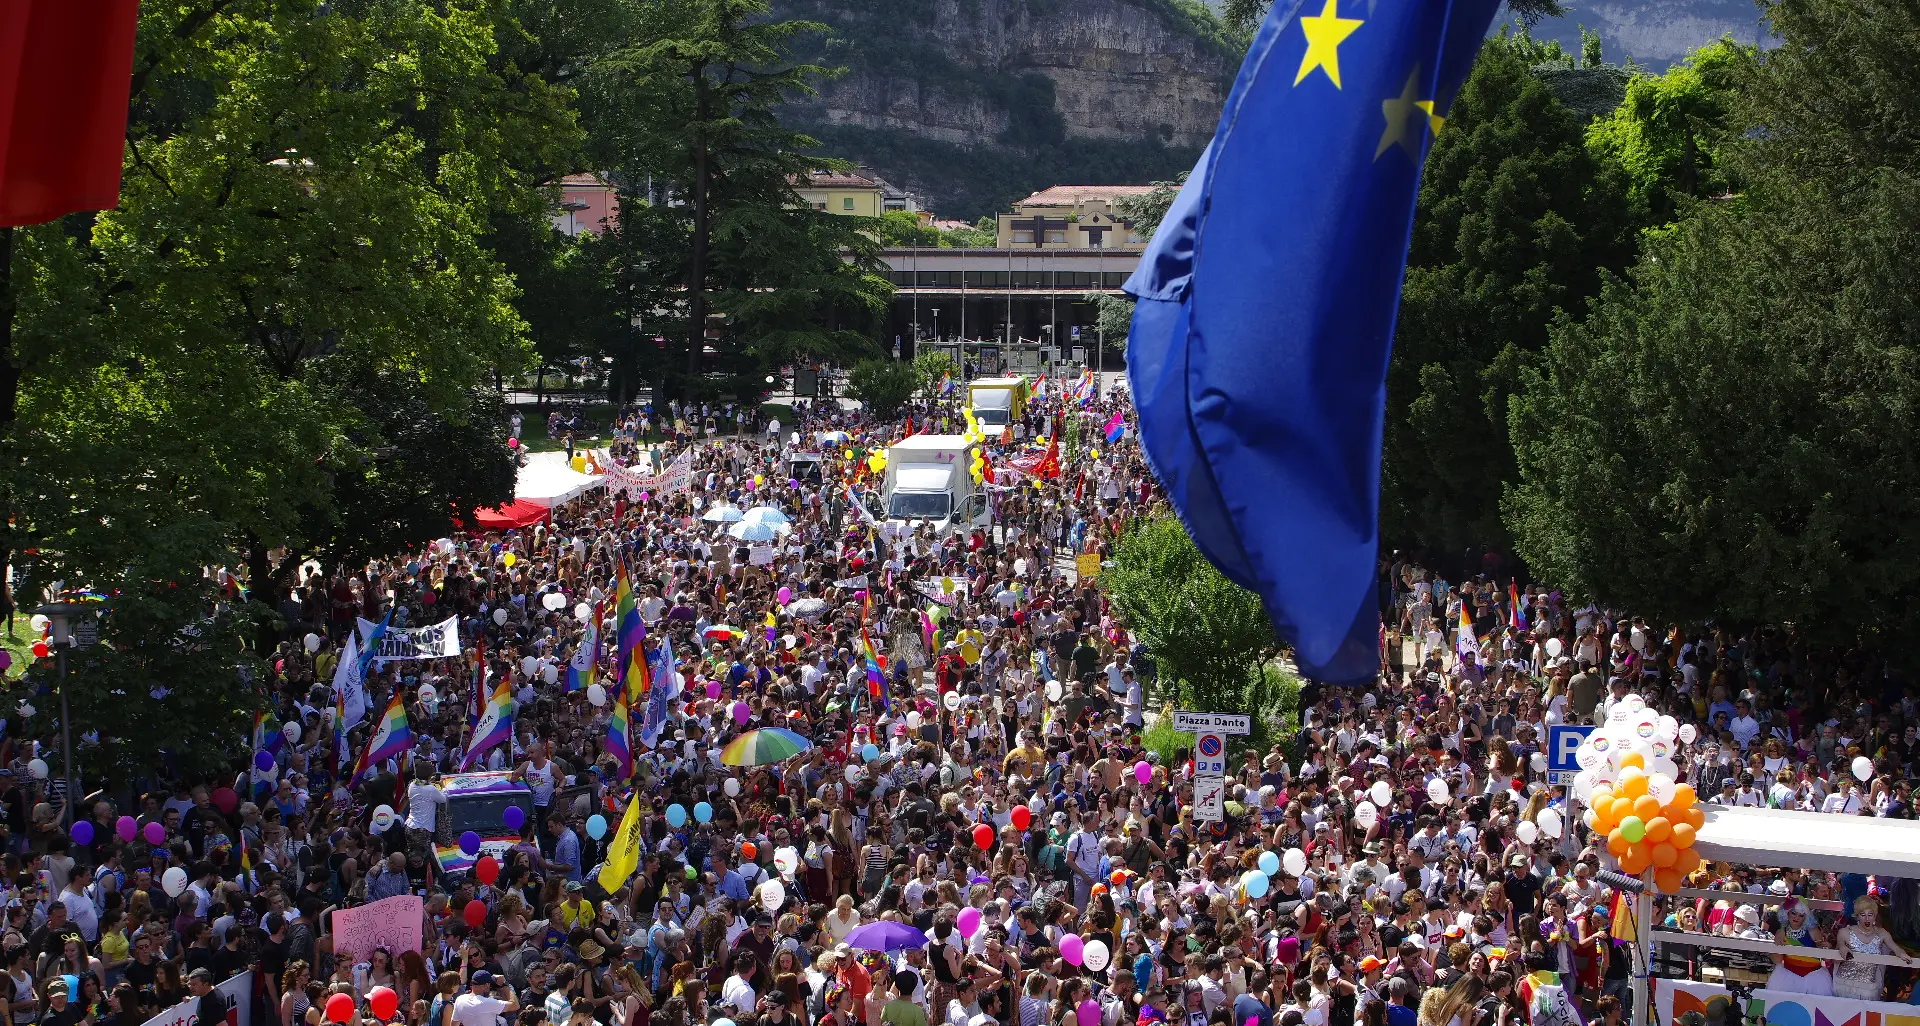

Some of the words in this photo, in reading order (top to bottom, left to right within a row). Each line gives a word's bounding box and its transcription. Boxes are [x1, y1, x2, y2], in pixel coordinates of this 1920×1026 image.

[1178, 716, 1210, 727] Piazza
[1214, 717, 1246, 728] Dante
[1557, 731, 1585, 765] P
